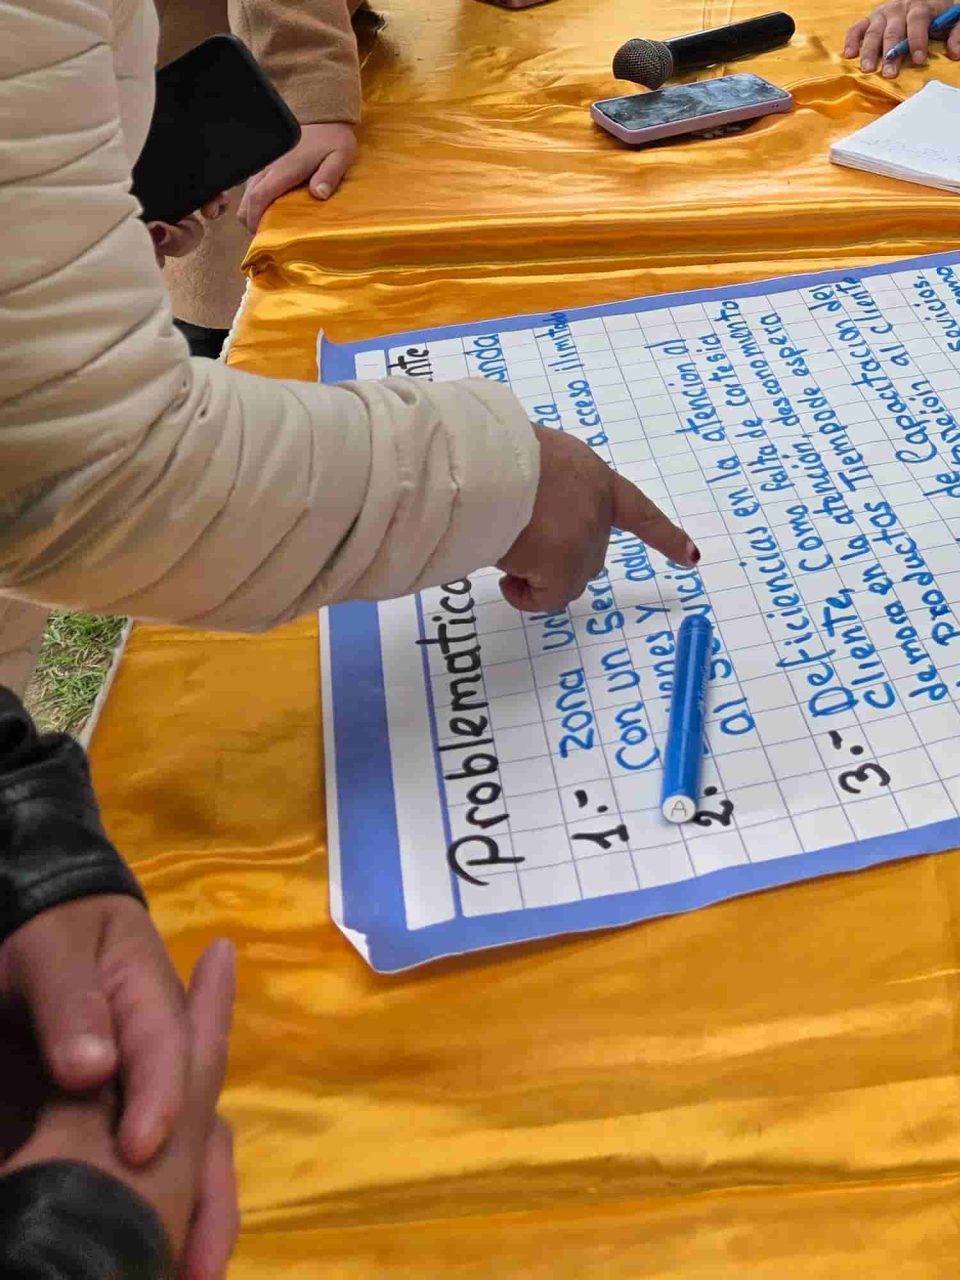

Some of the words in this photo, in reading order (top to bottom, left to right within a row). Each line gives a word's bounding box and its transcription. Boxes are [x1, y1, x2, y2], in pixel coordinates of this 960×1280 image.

[644, 338, 689, 355] al
[759, 312, 809, 377] espera
[879, 344, 910, 367] al
[734, 416, 768, 439] de
[706, 455, 741, 484] la
[745, 444, 795, 492] falta
[728, 488, 761, 518] en
[839, 534, 871, 560] la
[862, 564, 895, 595] en
[738, 526, 858, 718] Deficiencias
[882, 599, 948, 701] demora
[712, 698, 756, 736] al
